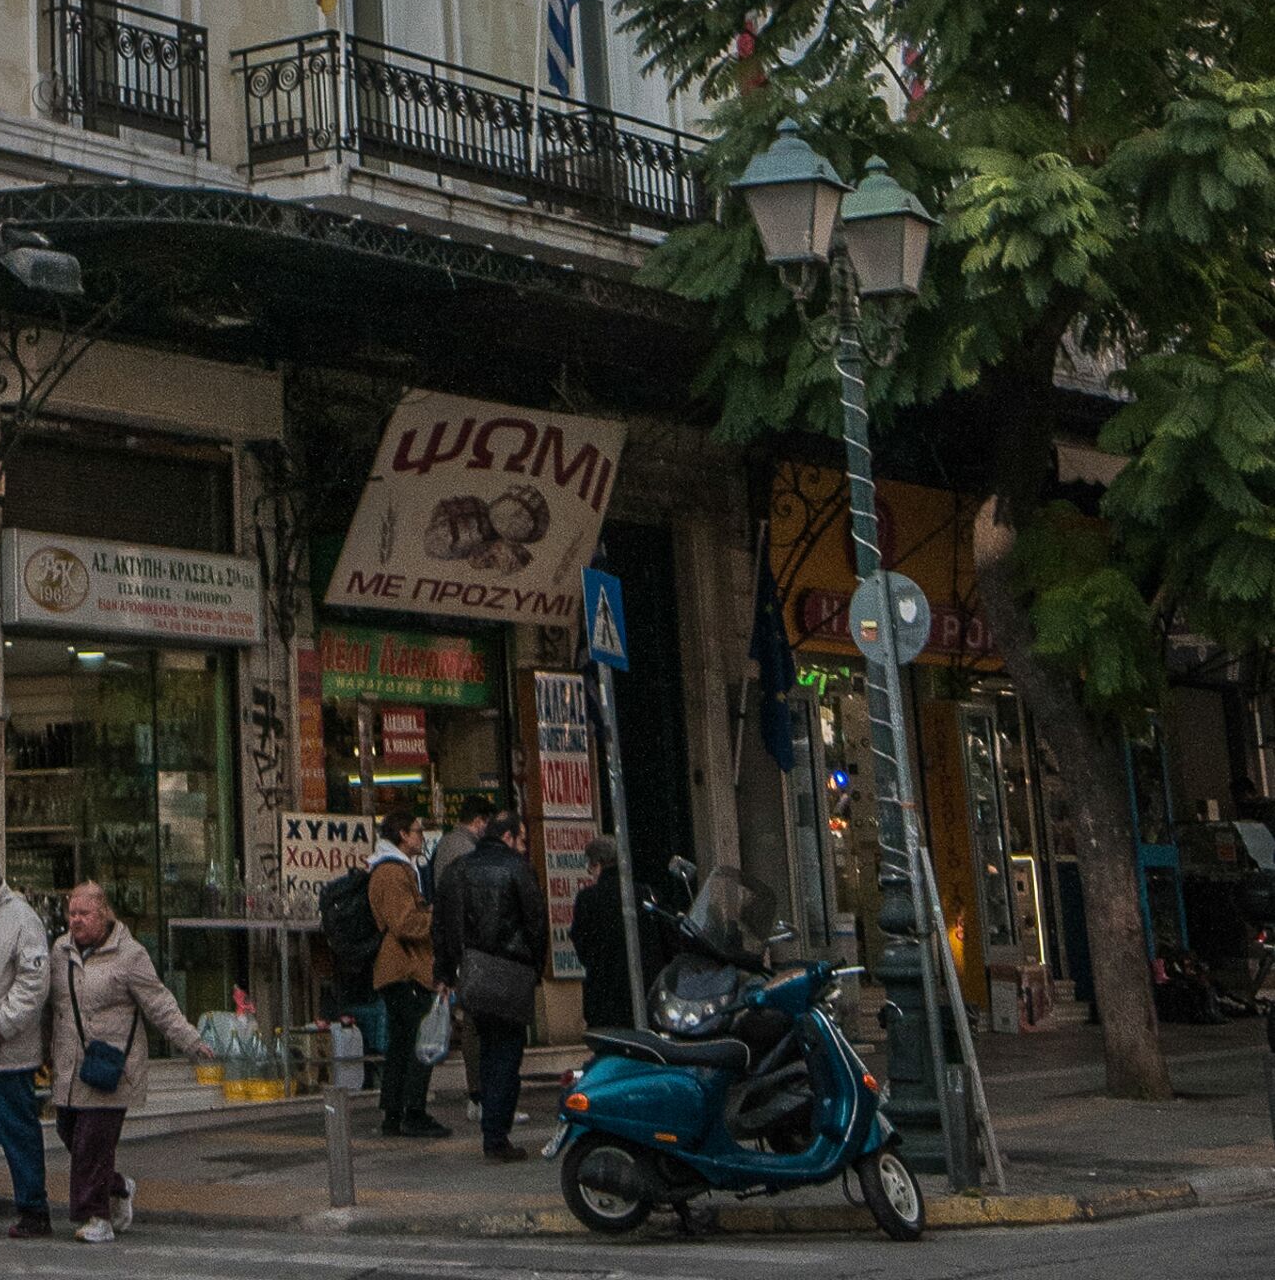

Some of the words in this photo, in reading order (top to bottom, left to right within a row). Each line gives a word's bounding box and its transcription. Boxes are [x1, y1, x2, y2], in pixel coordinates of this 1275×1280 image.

[392, 417, 612, 513] ΨΩΜΙ
[346, 571, 406, 597] ΜΕ
[411, 578, 574, 617] ΠΡΟΖΥΜΙ
[286, 819, 369, 843] ΧΥΜΑ
[286, 846, 370, 872] Χαλβάς
